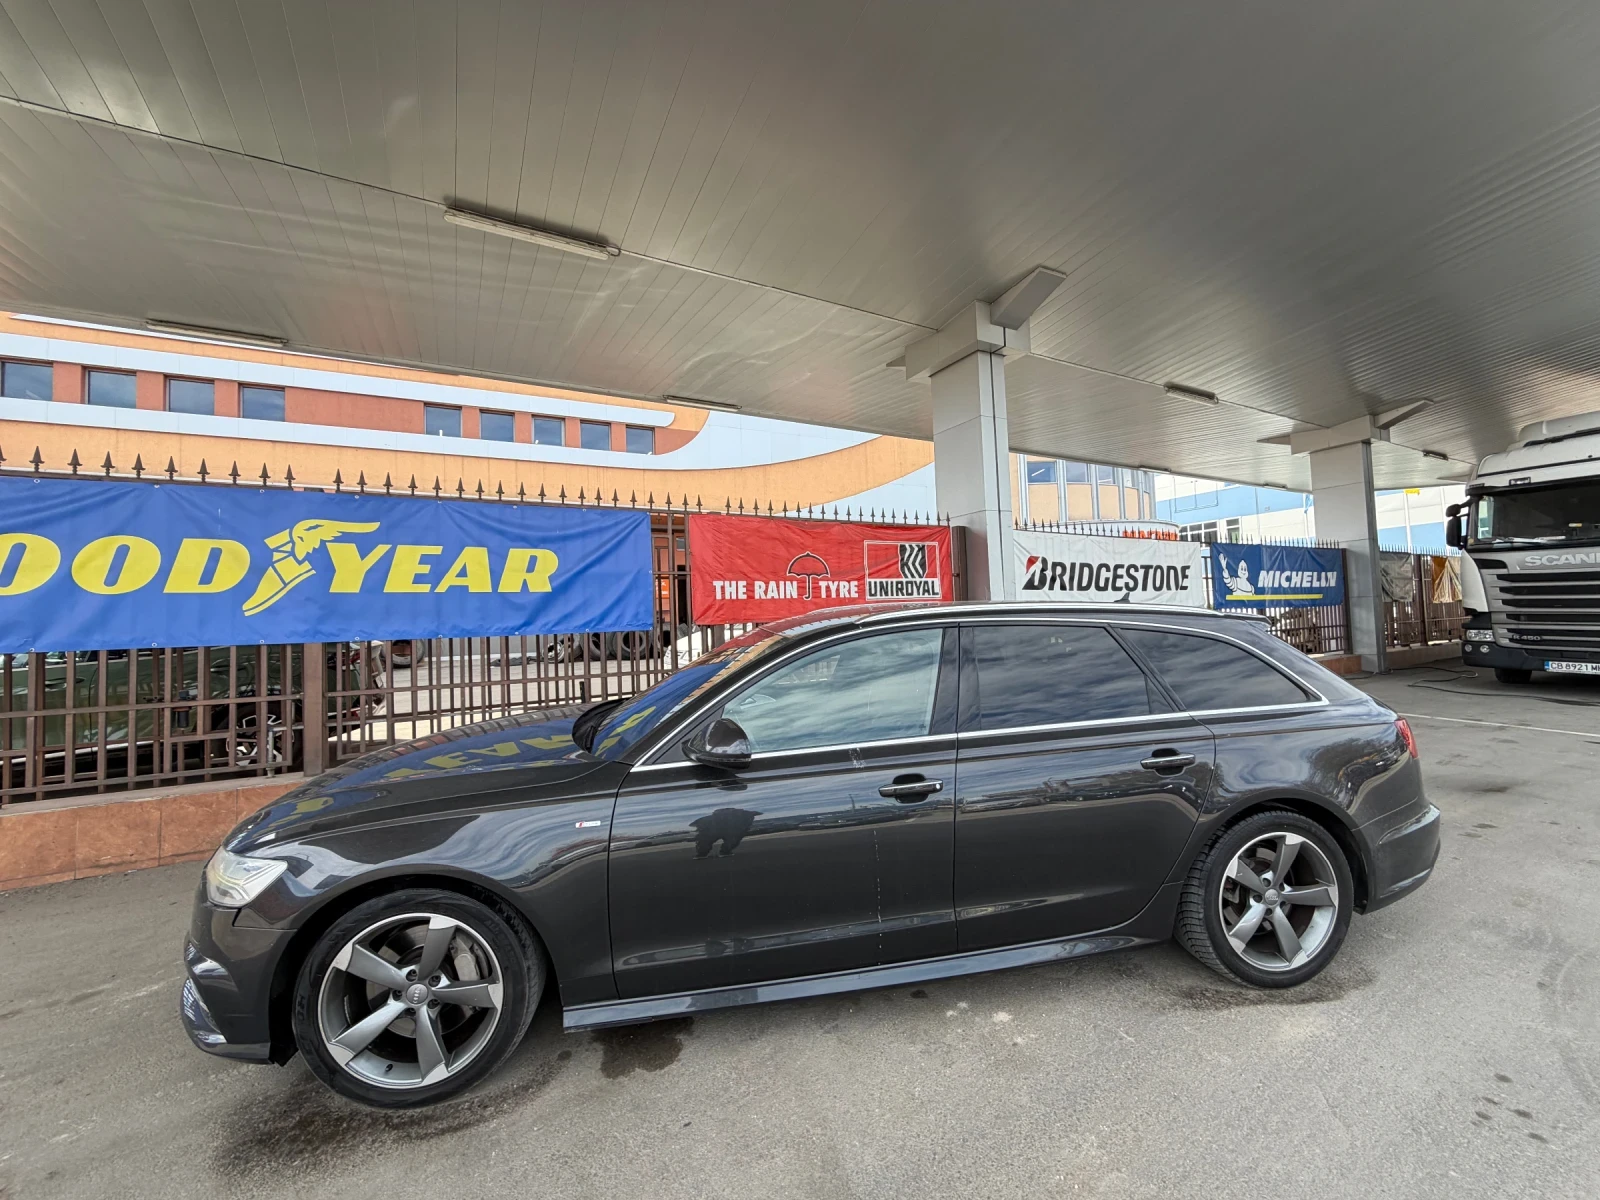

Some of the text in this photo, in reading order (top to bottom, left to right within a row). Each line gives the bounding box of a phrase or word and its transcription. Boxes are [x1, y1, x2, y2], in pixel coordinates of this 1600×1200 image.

[325, 543, 559, 594] YEAR
[1022, 555, 1191, 593] BRIDGESTONE
[867, 580, 940, 597] UNIROYAL
[1257, 570, 1338, 588] MICHELIN
[712, 580, 859, 600] THE RAIN TYRE
[1565, 662, 1588, 671] 8921
